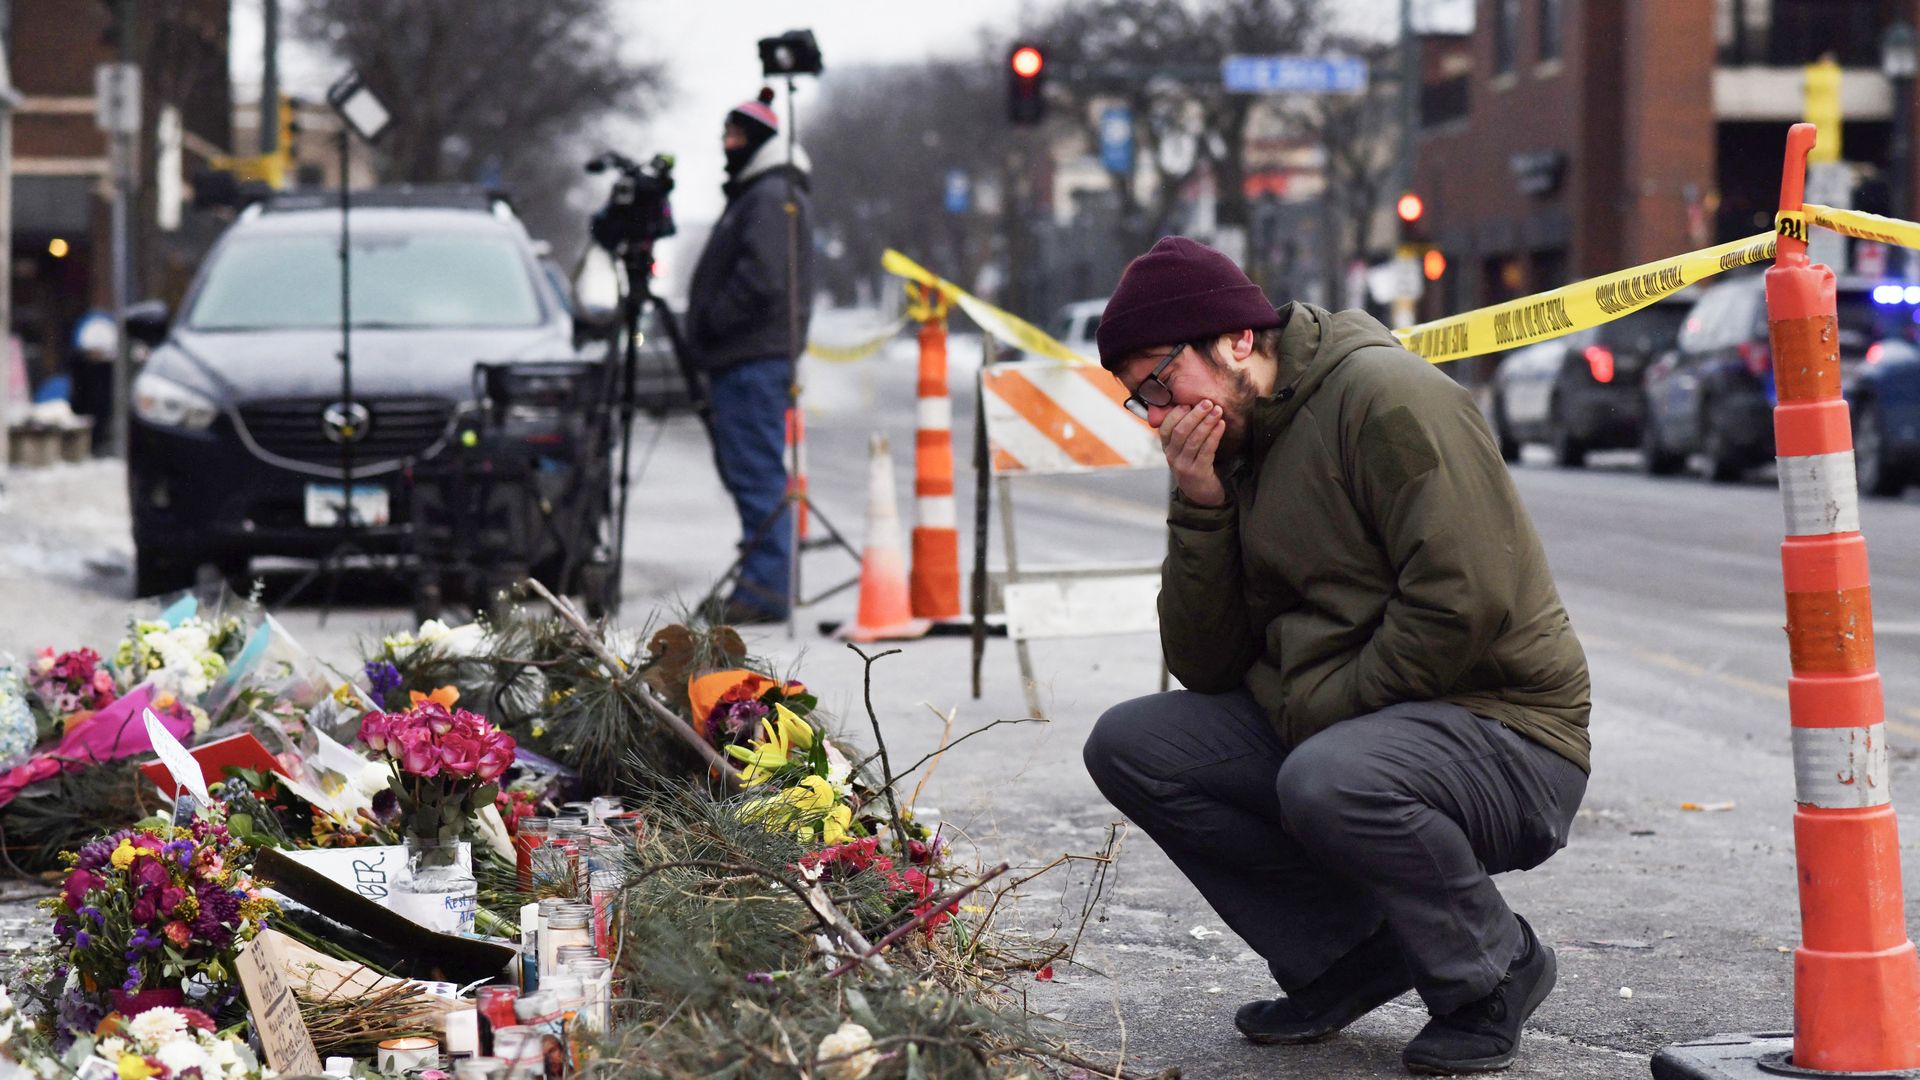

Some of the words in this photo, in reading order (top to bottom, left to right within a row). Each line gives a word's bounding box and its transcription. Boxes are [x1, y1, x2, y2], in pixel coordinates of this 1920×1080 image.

[1618, 279, 1638, 306] NOT
[1632, 276, 1647, 300] DO
[1643, 272, 1662, 296] LINE
[1659, 265, 1685, 290] POLICE
[1546, 297, 1573, 330] POLICE
[1596, 282, 1630, 314] CROSS
[1494, 311, 1514, 344] CROSS
[1512, 308, 1528, 340] NOT
[1524, 306, 1538, 338] DO
[1533, 302, 1551, 335] LINE
[353, 851, 389, 899] BER.
[445, 894, 467, 909] Rest
[459, 911, 475, 923] Ale
